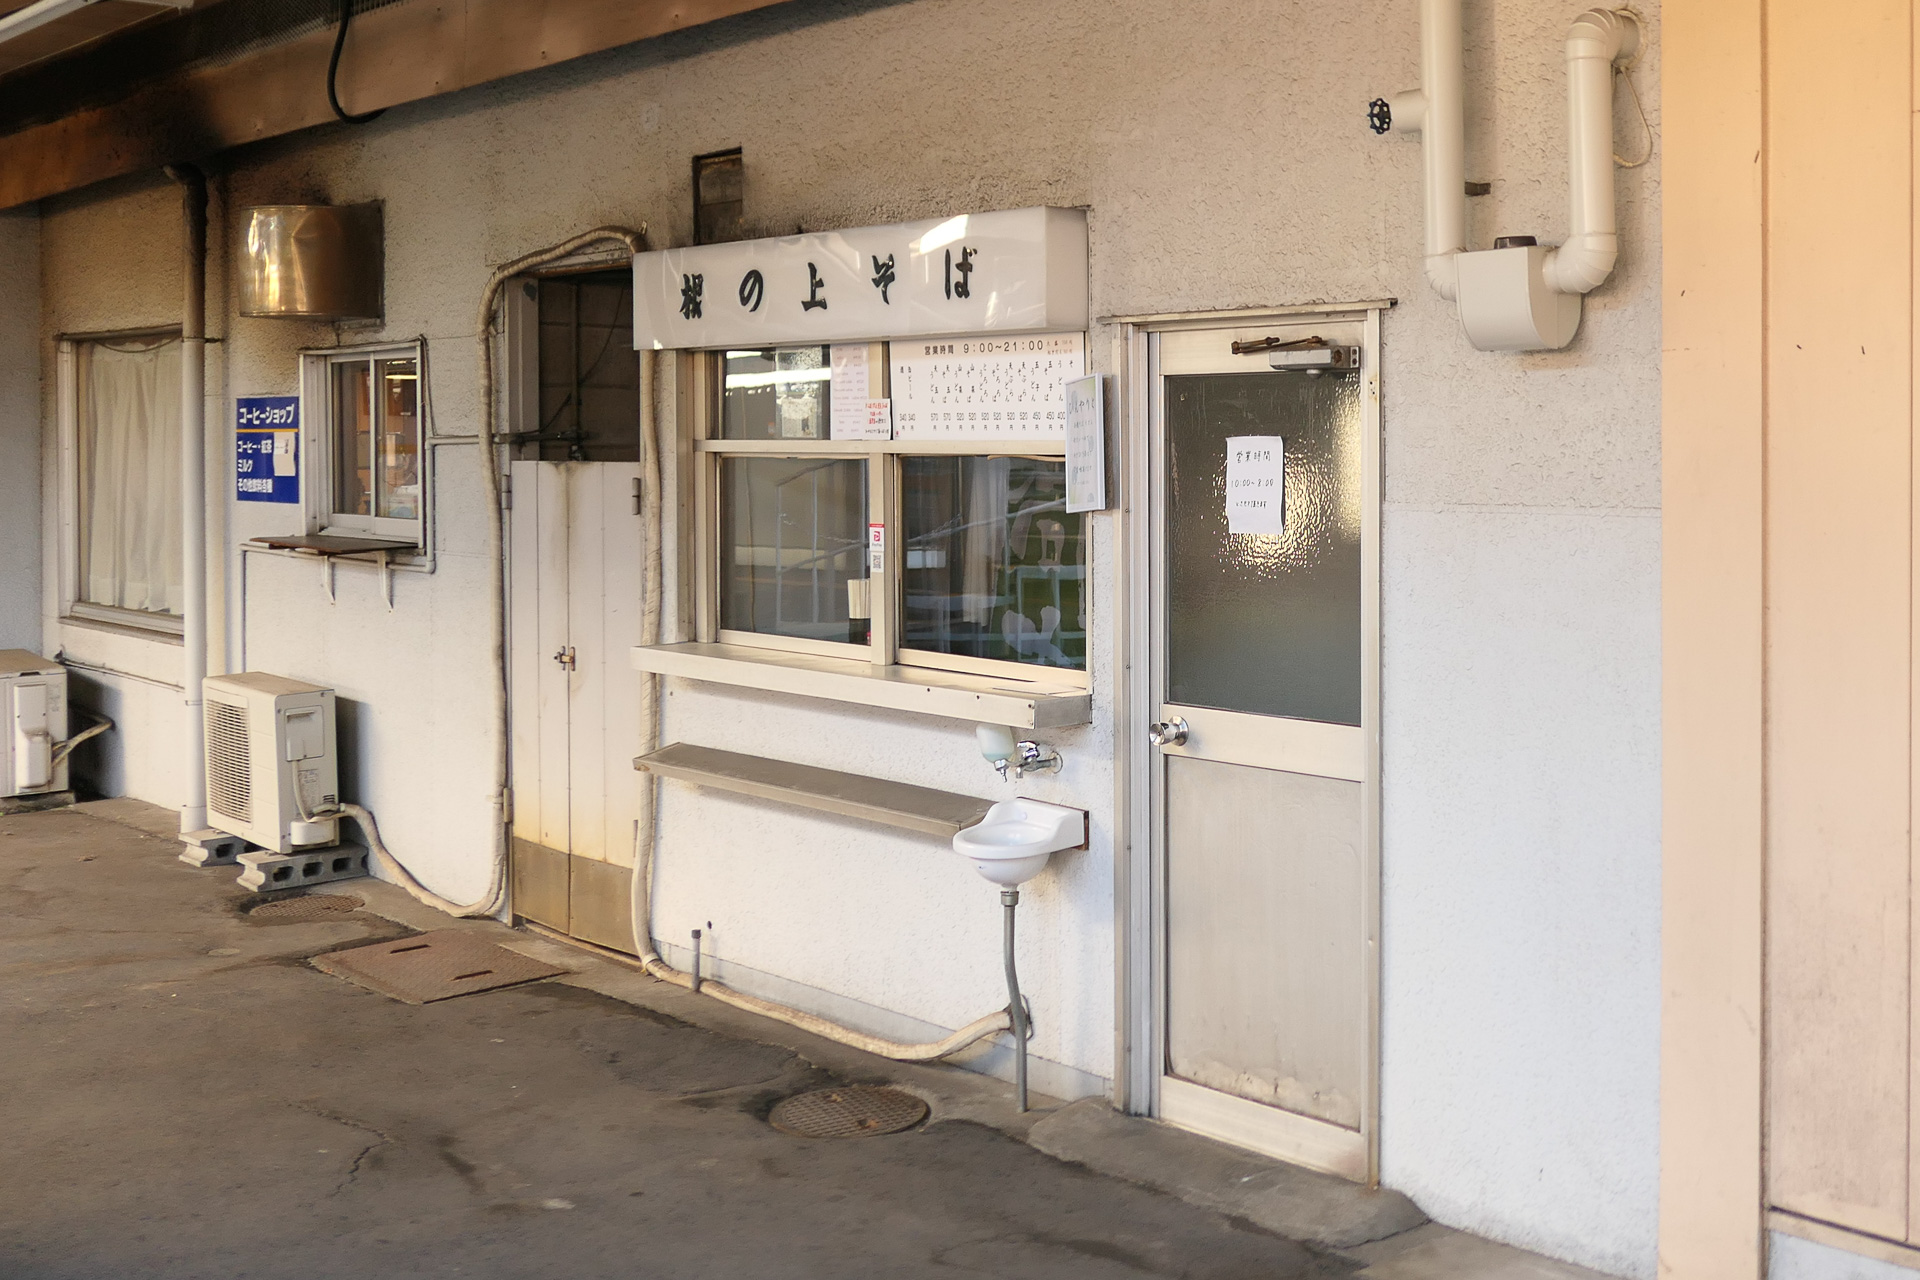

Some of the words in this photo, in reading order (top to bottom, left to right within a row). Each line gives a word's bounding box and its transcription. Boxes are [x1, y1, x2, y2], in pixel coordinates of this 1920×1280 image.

[924, 344, 954, 356] 営業時間
[239, 403, 294, 424] コーヒーショップ
[1236, 450, 1271, 463] 営業時間
[238, 458, 253, 472] ミルク
